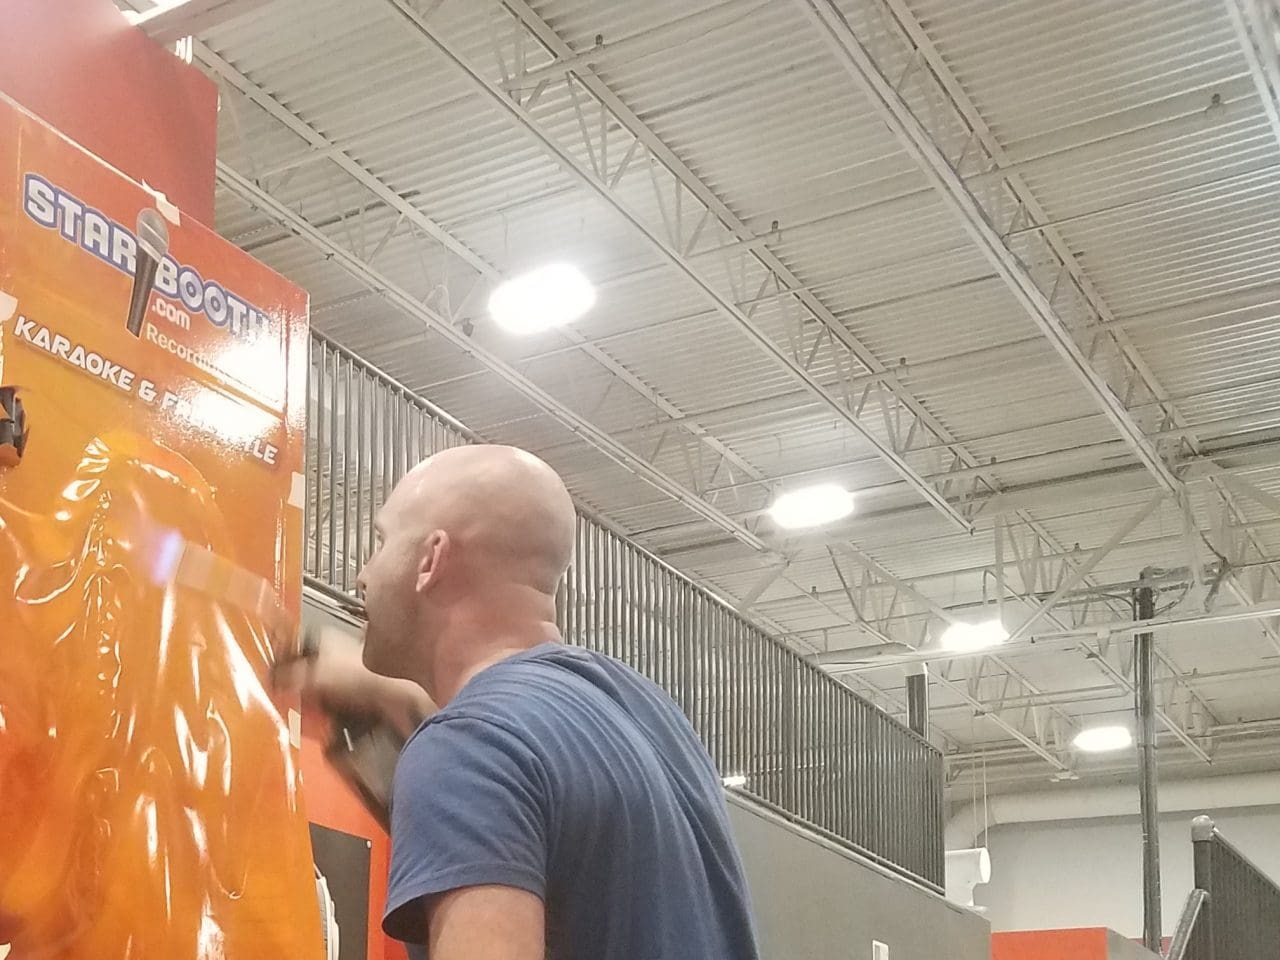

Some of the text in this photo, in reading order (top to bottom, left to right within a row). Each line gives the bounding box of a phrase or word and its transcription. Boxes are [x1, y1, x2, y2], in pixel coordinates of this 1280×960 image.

[24, 176, 137, 273] STAR
[152, 299, 190, 330] .com
[14, 316, 157, 402] KARAOKE &
